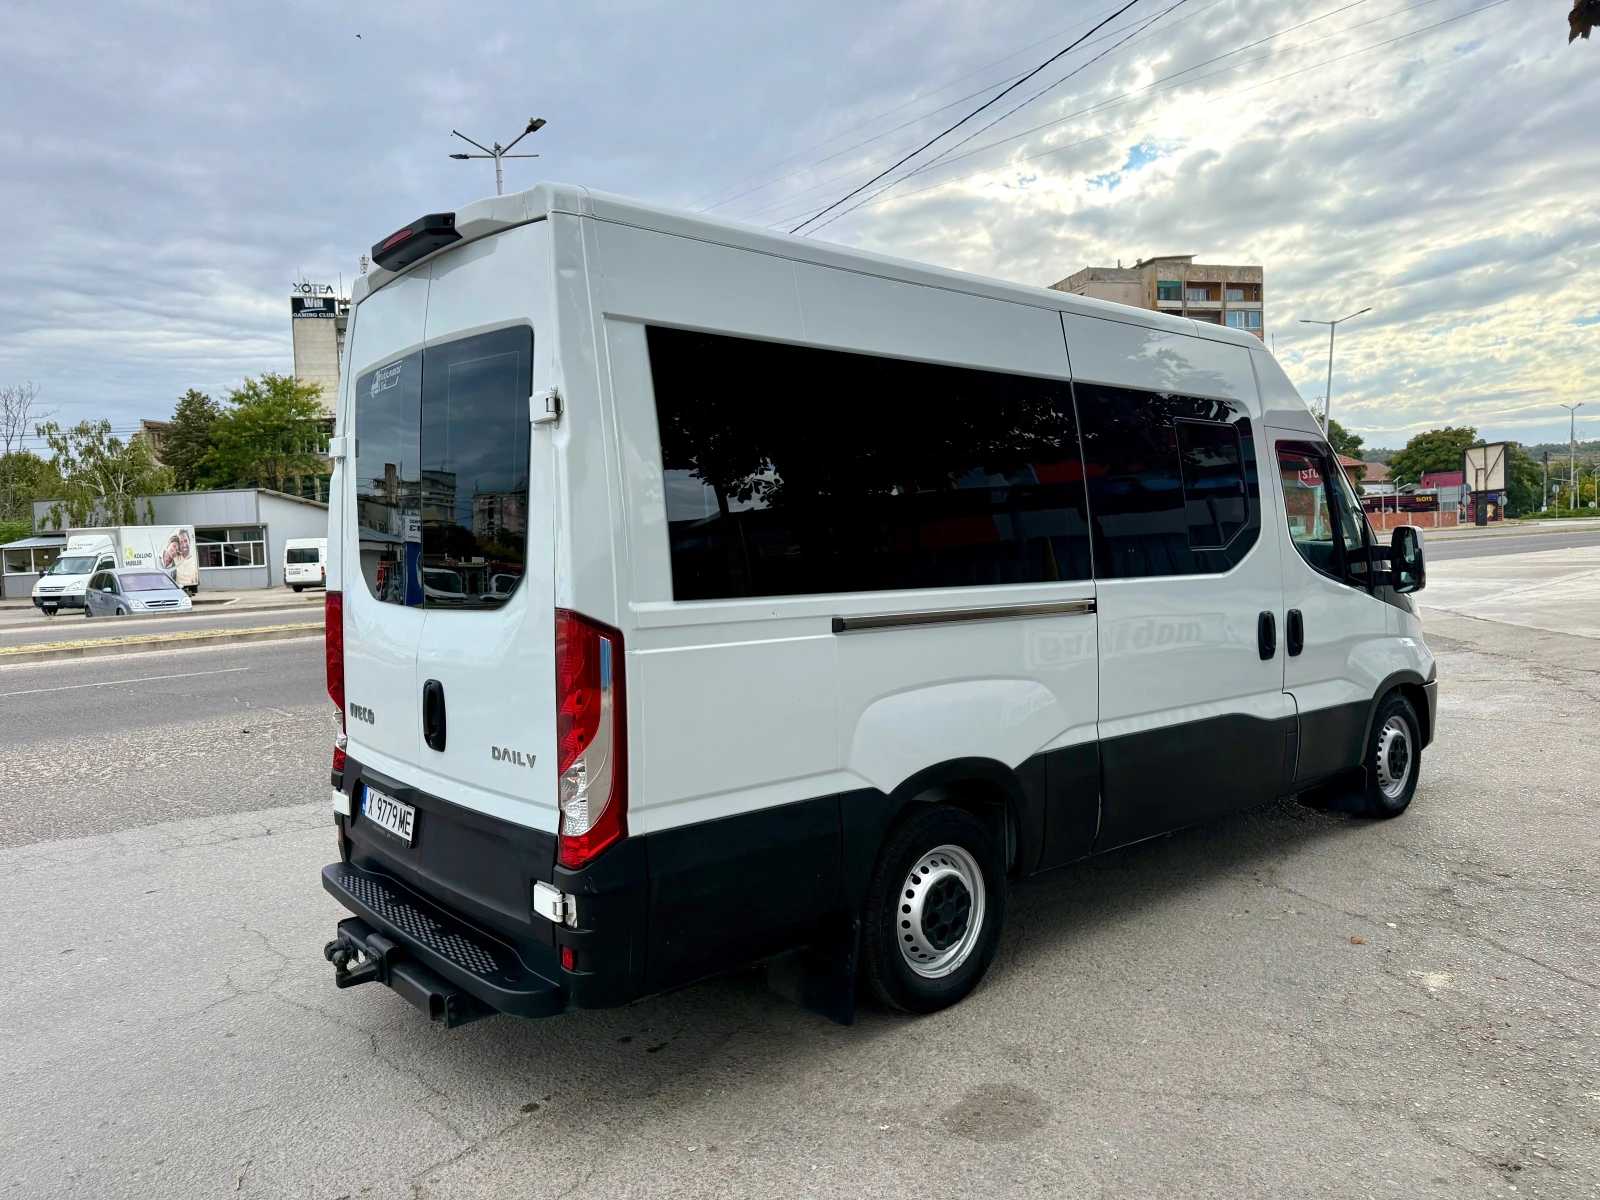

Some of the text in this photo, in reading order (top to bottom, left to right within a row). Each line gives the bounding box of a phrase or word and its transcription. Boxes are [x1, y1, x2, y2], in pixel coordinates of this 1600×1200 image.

[303, 298, 323, 307] WIN
[350, 702, 375, 725] IVECO
[491, 746, 537, 769] DAILY
[377, 797, 398, 829] 9779
[397, 807, 413, 837] ME
